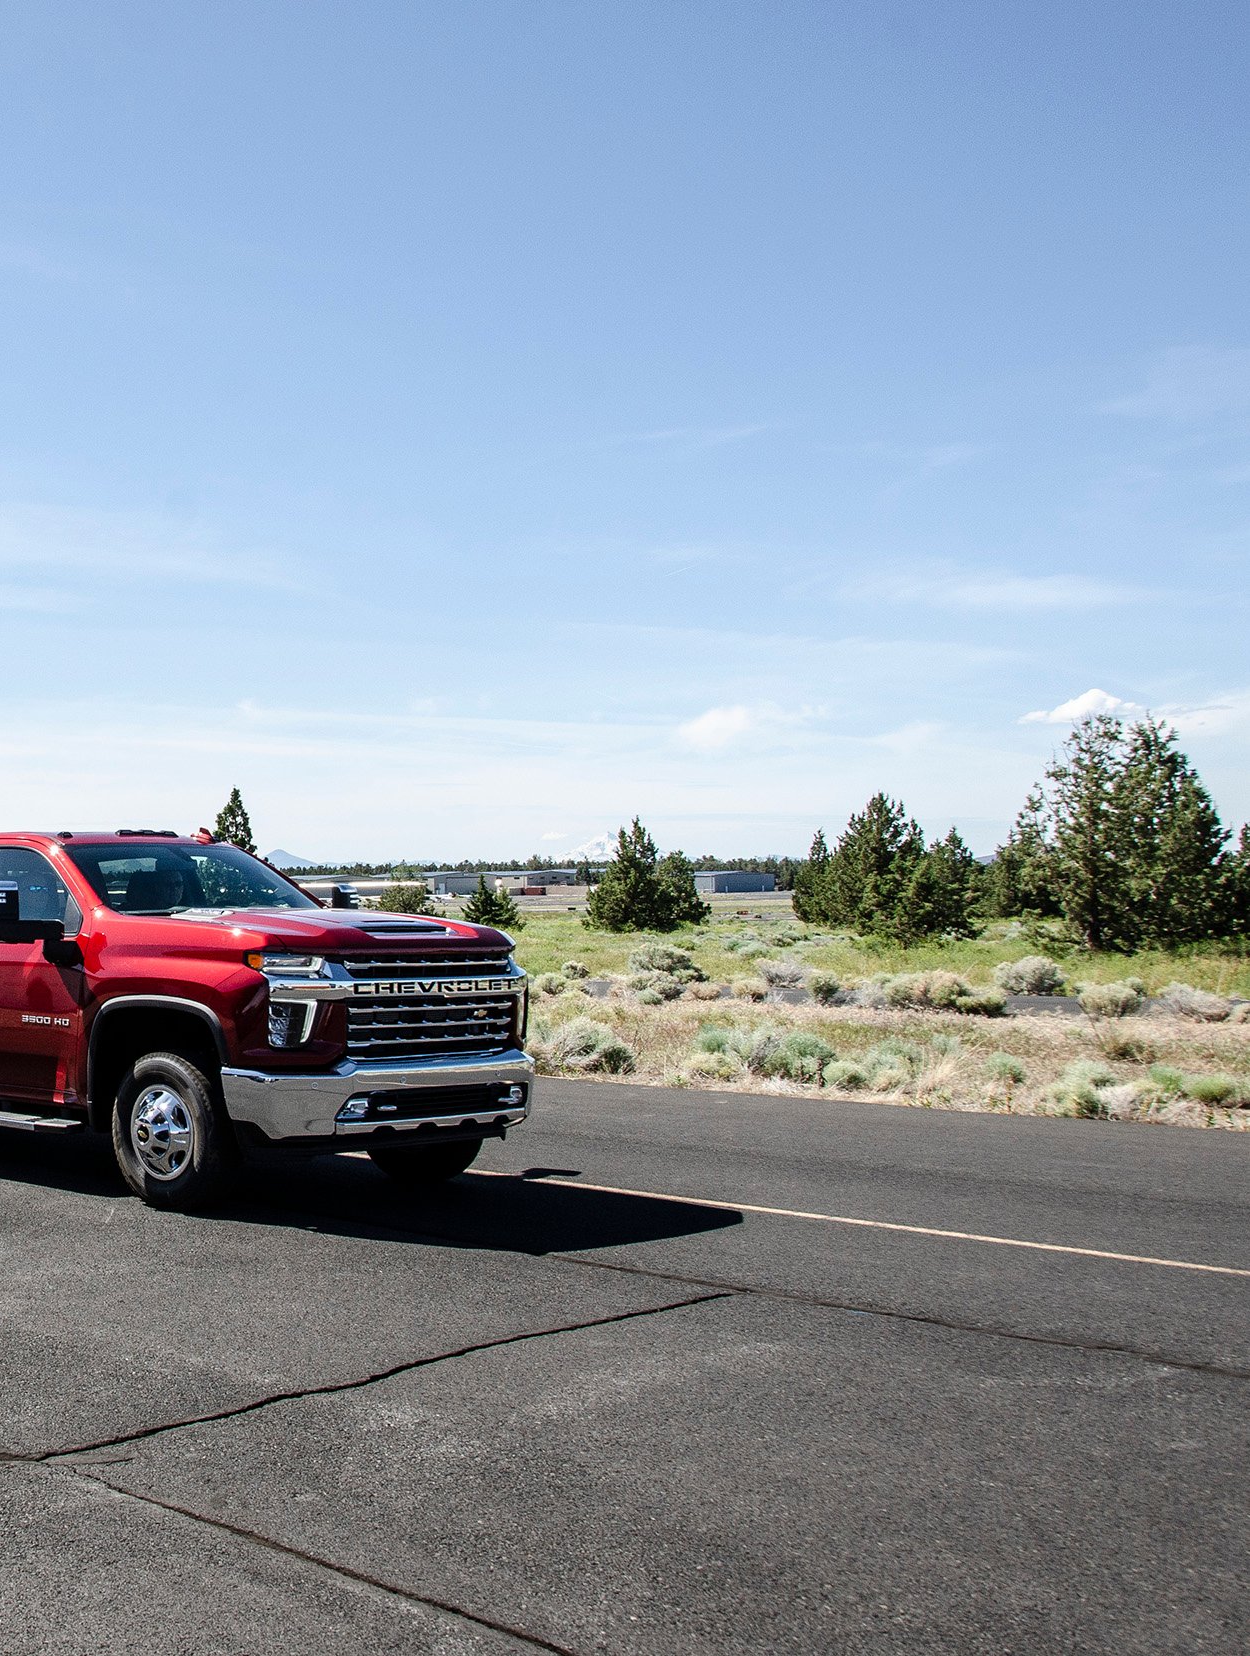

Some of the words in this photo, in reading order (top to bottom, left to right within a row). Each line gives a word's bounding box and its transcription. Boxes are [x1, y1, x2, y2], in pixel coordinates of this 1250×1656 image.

[353, 978, 515, 995] CHEVROLET
[21, 1014, 51, 1024] 3500
[54, 1017, 70, 1026] HD
